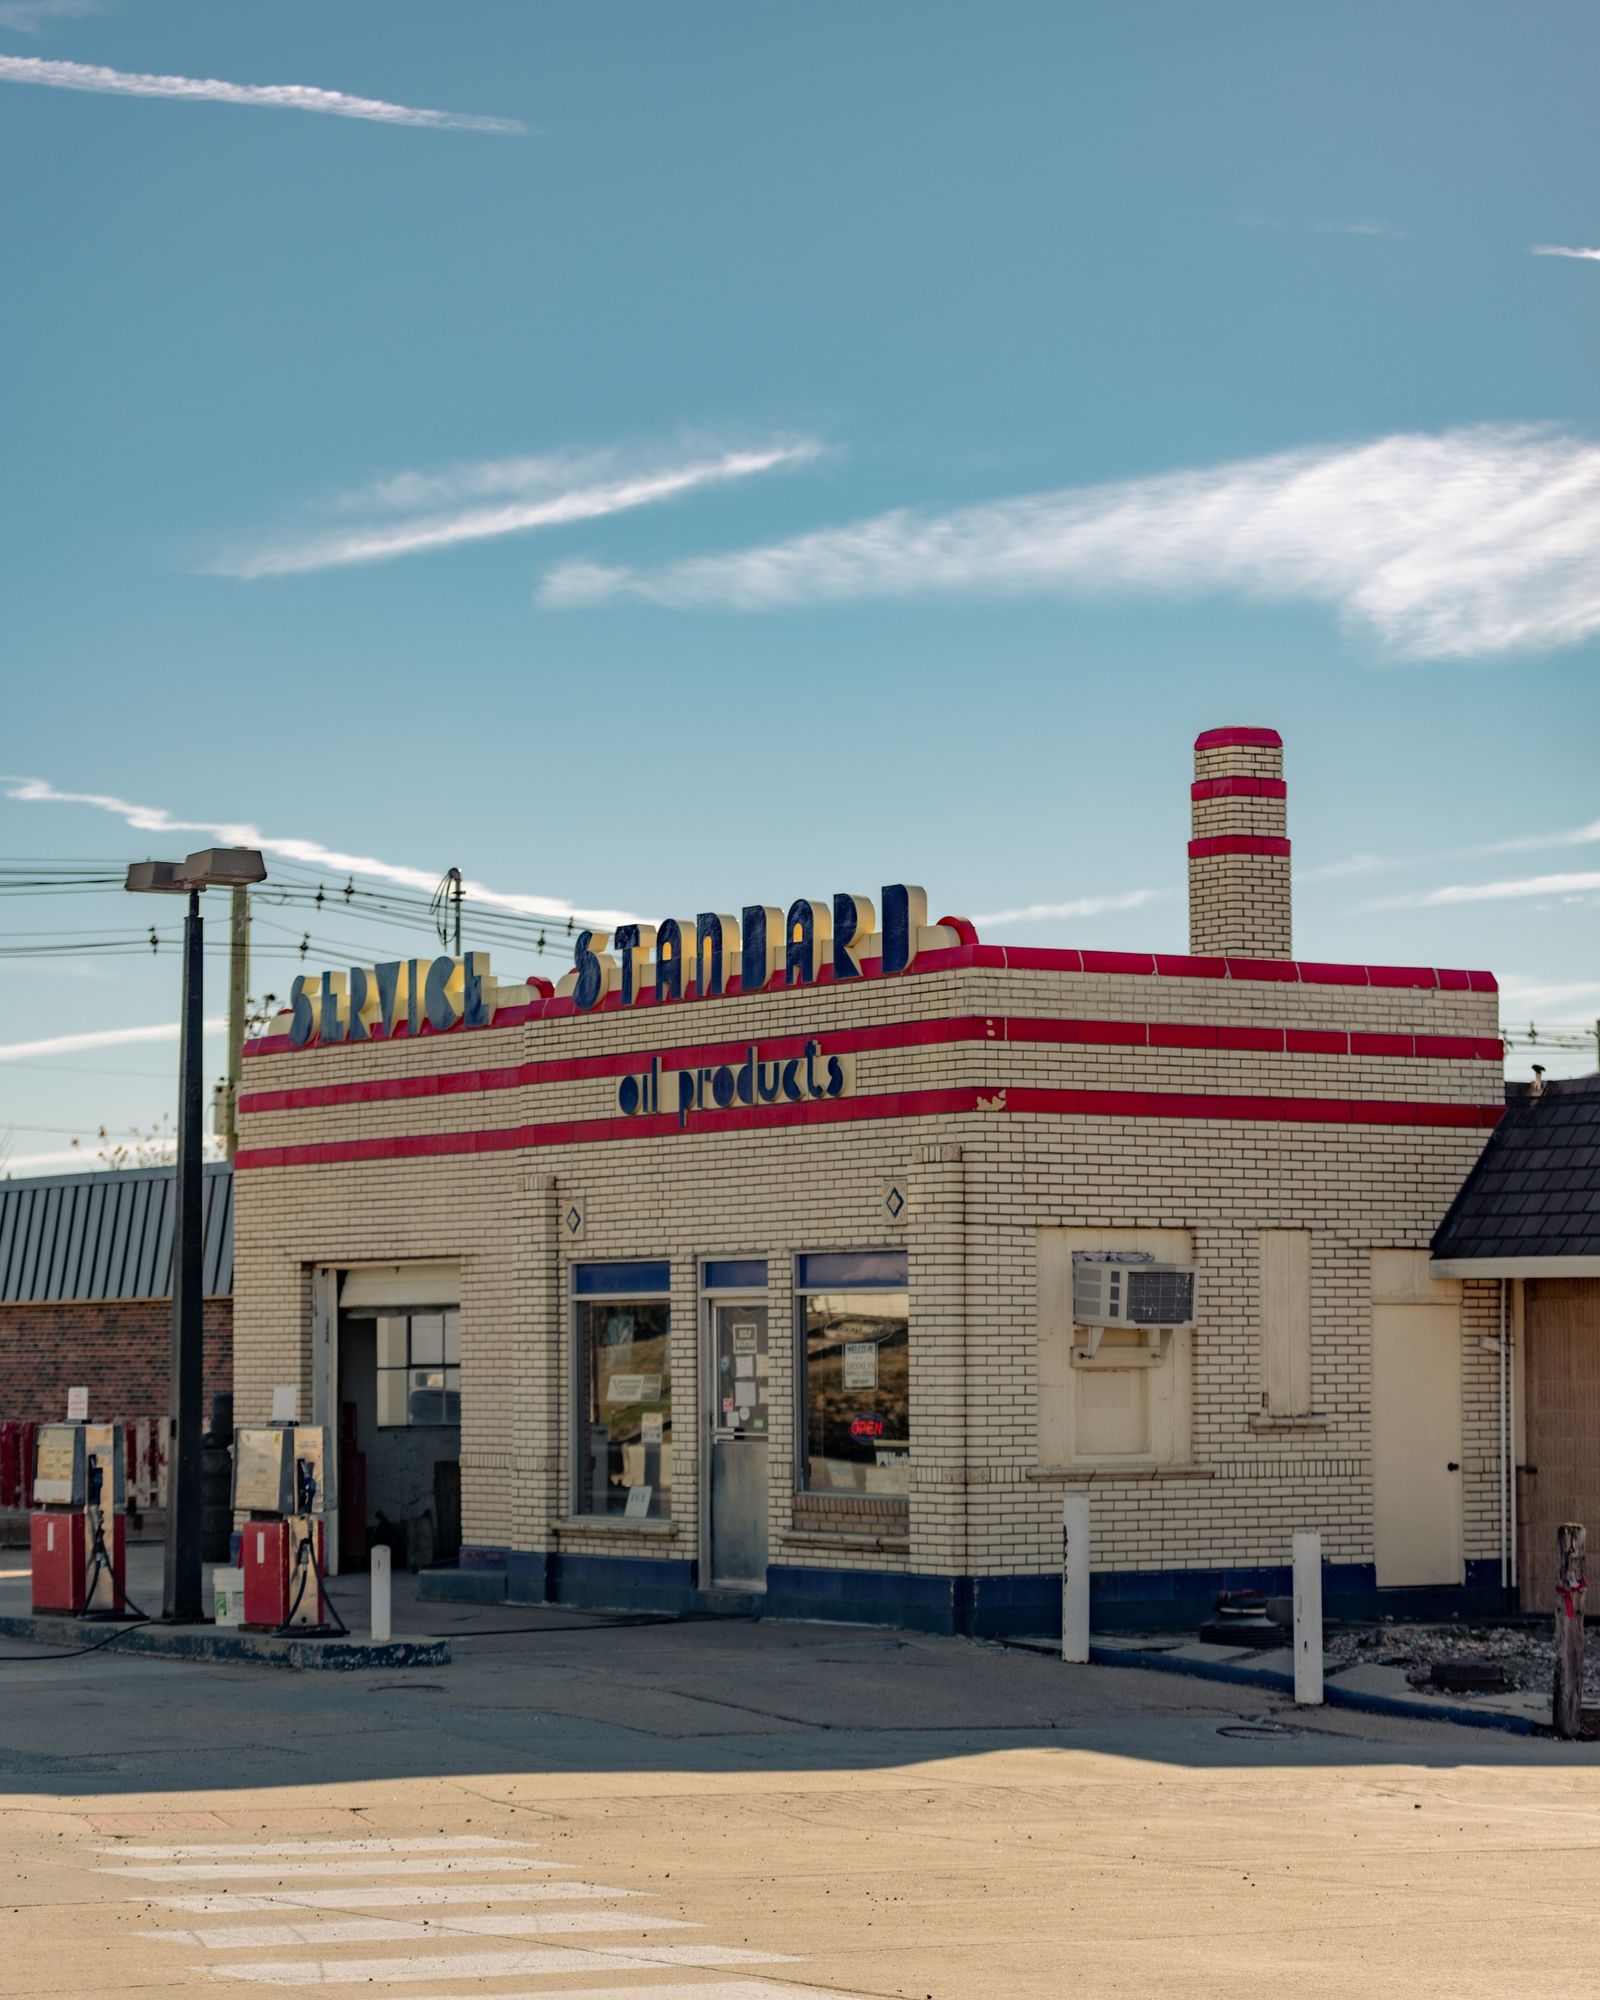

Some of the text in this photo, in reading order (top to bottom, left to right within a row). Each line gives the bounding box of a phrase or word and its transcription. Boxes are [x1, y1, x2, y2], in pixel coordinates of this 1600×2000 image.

[572, 884, 926, 1011] STANDARD
[289, 951, 495, 1047] SERVICE
[619, 1040, 844, 1128] oil products
[846, 1344, 875, 1354] WELCOME
[850, 1420, 883, 1436] OPEN
